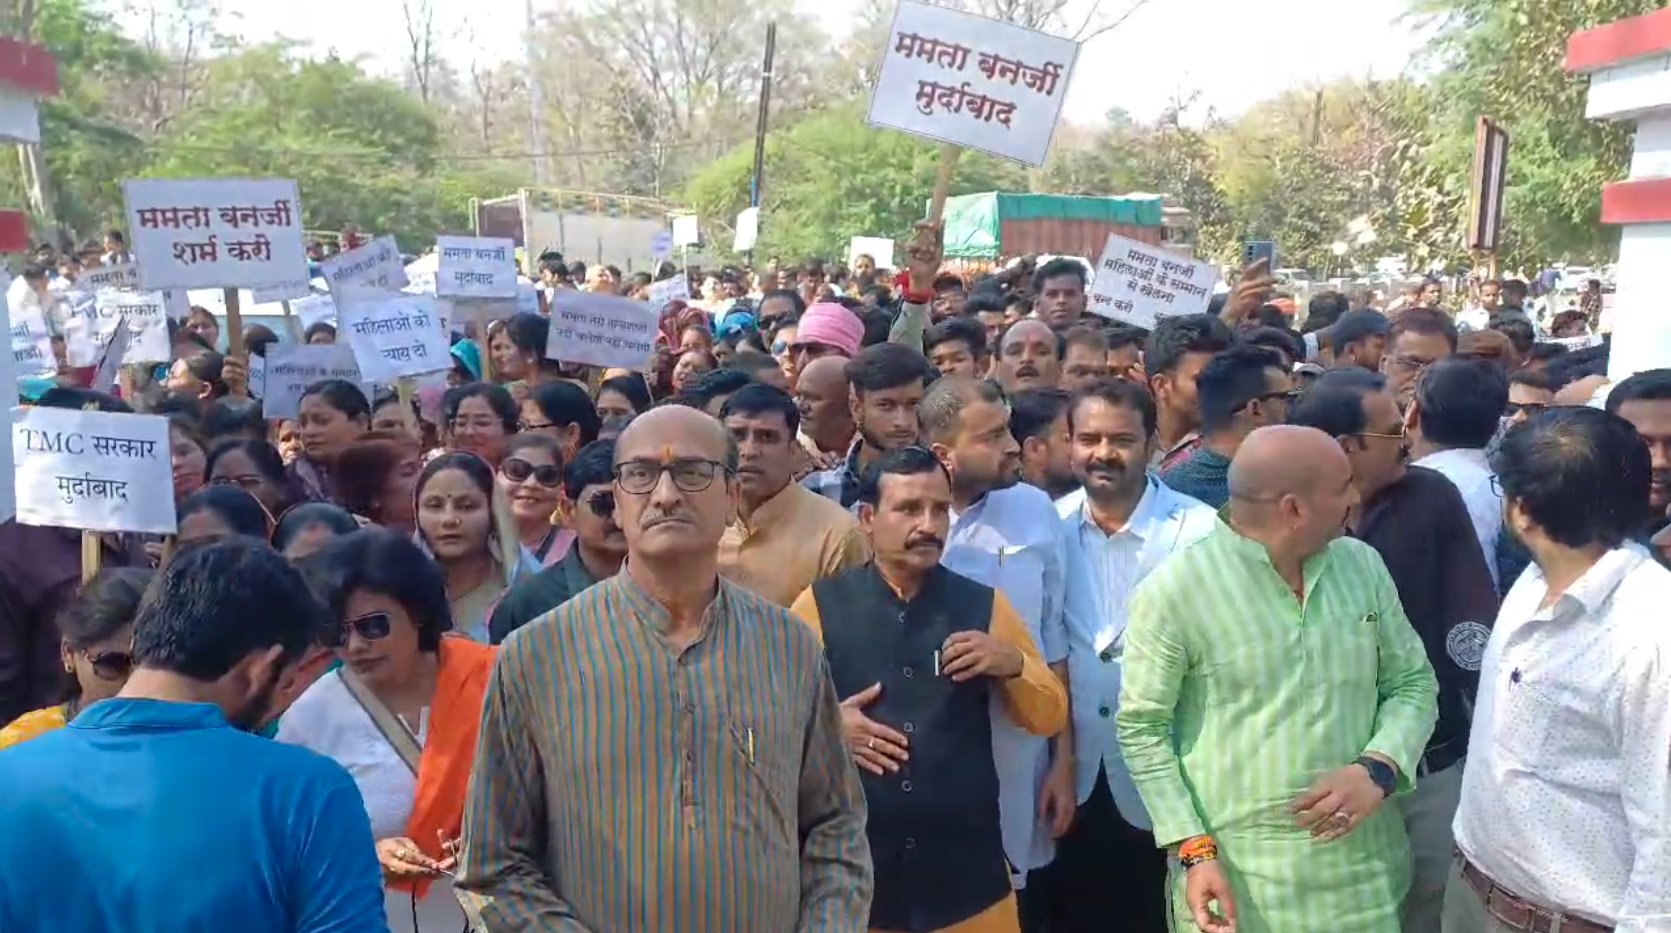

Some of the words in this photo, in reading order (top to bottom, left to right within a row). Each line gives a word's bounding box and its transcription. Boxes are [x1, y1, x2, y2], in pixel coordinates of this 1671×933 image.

[895, 32, 972, 71] ममता
[978, 52, 1064, 96] बनर्जी
[916, 80, 1017, 129] मुर्दाबाद
[136, 206, 210, 229] ममता
[218, 200, 291, 228] बनर्जी
[172, 235, 218, 265] शर्म
[224, 234, 271, 262] करो
[443, 247, 472, 259] ममता
[1127, 249, 1158, 267] ममता
[1156, 272, 1169, 286] के
[1170, 278, 1207, 298] सम्मान
[412, 309, 431, 328] को
[412, 340, 428, 357] दो
[20, 428, 84, 455] TMC
[91, 436, 157, 459] सरकार
[55, 472, 129, 504] मुर्दाबाद
